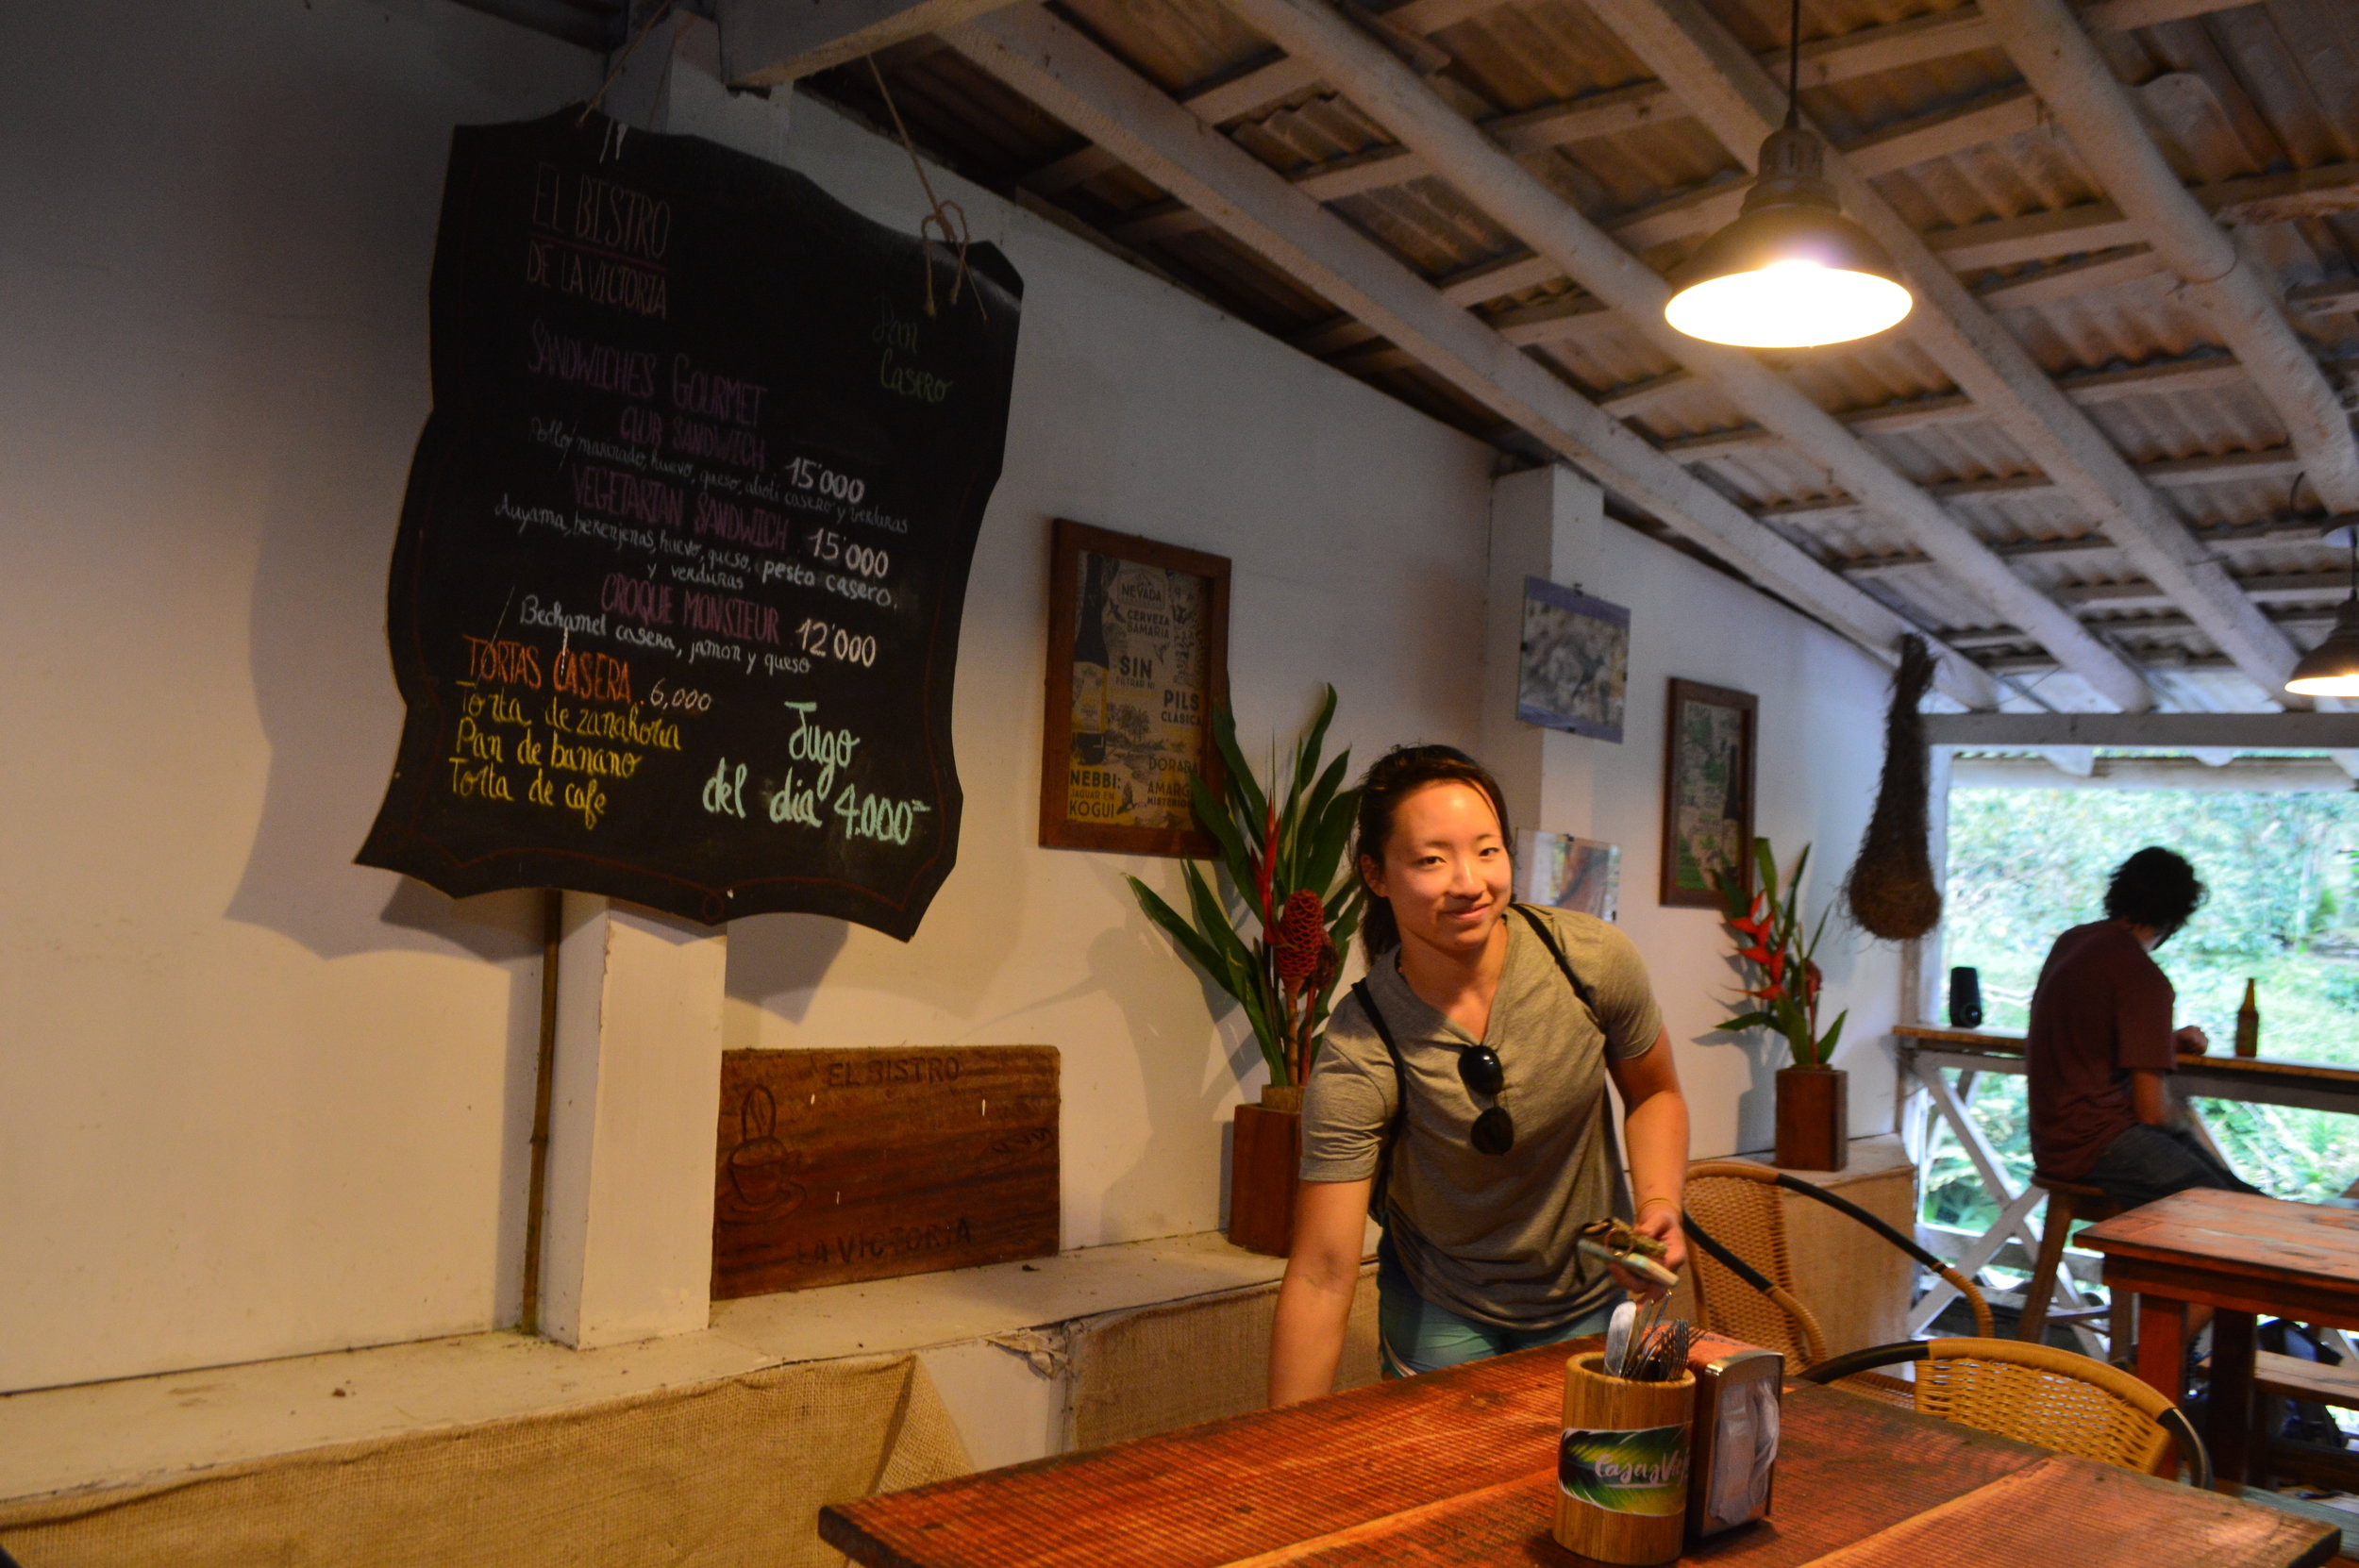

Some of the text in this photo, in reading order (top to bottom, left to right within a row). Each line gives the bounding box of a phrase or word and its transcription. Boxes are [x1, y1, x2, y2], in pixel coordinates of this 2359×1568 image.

[532, 161, 671, 259] EL BISTRO
[527, 240, 667, 320] DE LA VICTORIA
[528, 317, 768, 426] SANDWICHES GOURMET
[619, 406, 766, 471] CLUB SANDWICH
[528, 417, 573, 449] Pollo
[784, 490, 835, 514] casero
[837, 501, 846, 525] y
[848, 506, 908, 535] verduras
[572, 462, 789, 552] VEGETARIAN SANDWICH
[647, 562, 745, 591] y verduras
[1121, 584, 1162, 603] NEVADA
[520, 593, 607, 636] Bechamel
[689, 638, 741, 664] jamon
[745, 651, 757, 676] y
[764, 651, 811, 676] queso
[601, 572, 780, 645] CROQUE MONSIEUR
[1127, 609, 1169, 626] CERVEZA
[1127, 623, 1169, 640] SAMARIA
[461, 635, 543, 691] TORTAS
[649, 677, 712, 712] 6,000
[1120, 656, 1152, 679] SIN
[454, 680, 683, 751] Torta de zanahoria
[1163, 690, 1200, 710] PILS
[456, 717, 642, 778] Pan de banano
[784, 701, 861, 801] Jugo
[449, 757, 607, 830] Torta de cafe
[702, 757, 746, 819] del
[1069, 800, 1114, 819] KOGUI
[1103, 790, 1115, 801] EN
[1147, 781, 1193, 798] AMARG
[827, 1056, 961, 1087] EL BISTRO
[796, 1217, 972, 1265] LA VICTORIA
